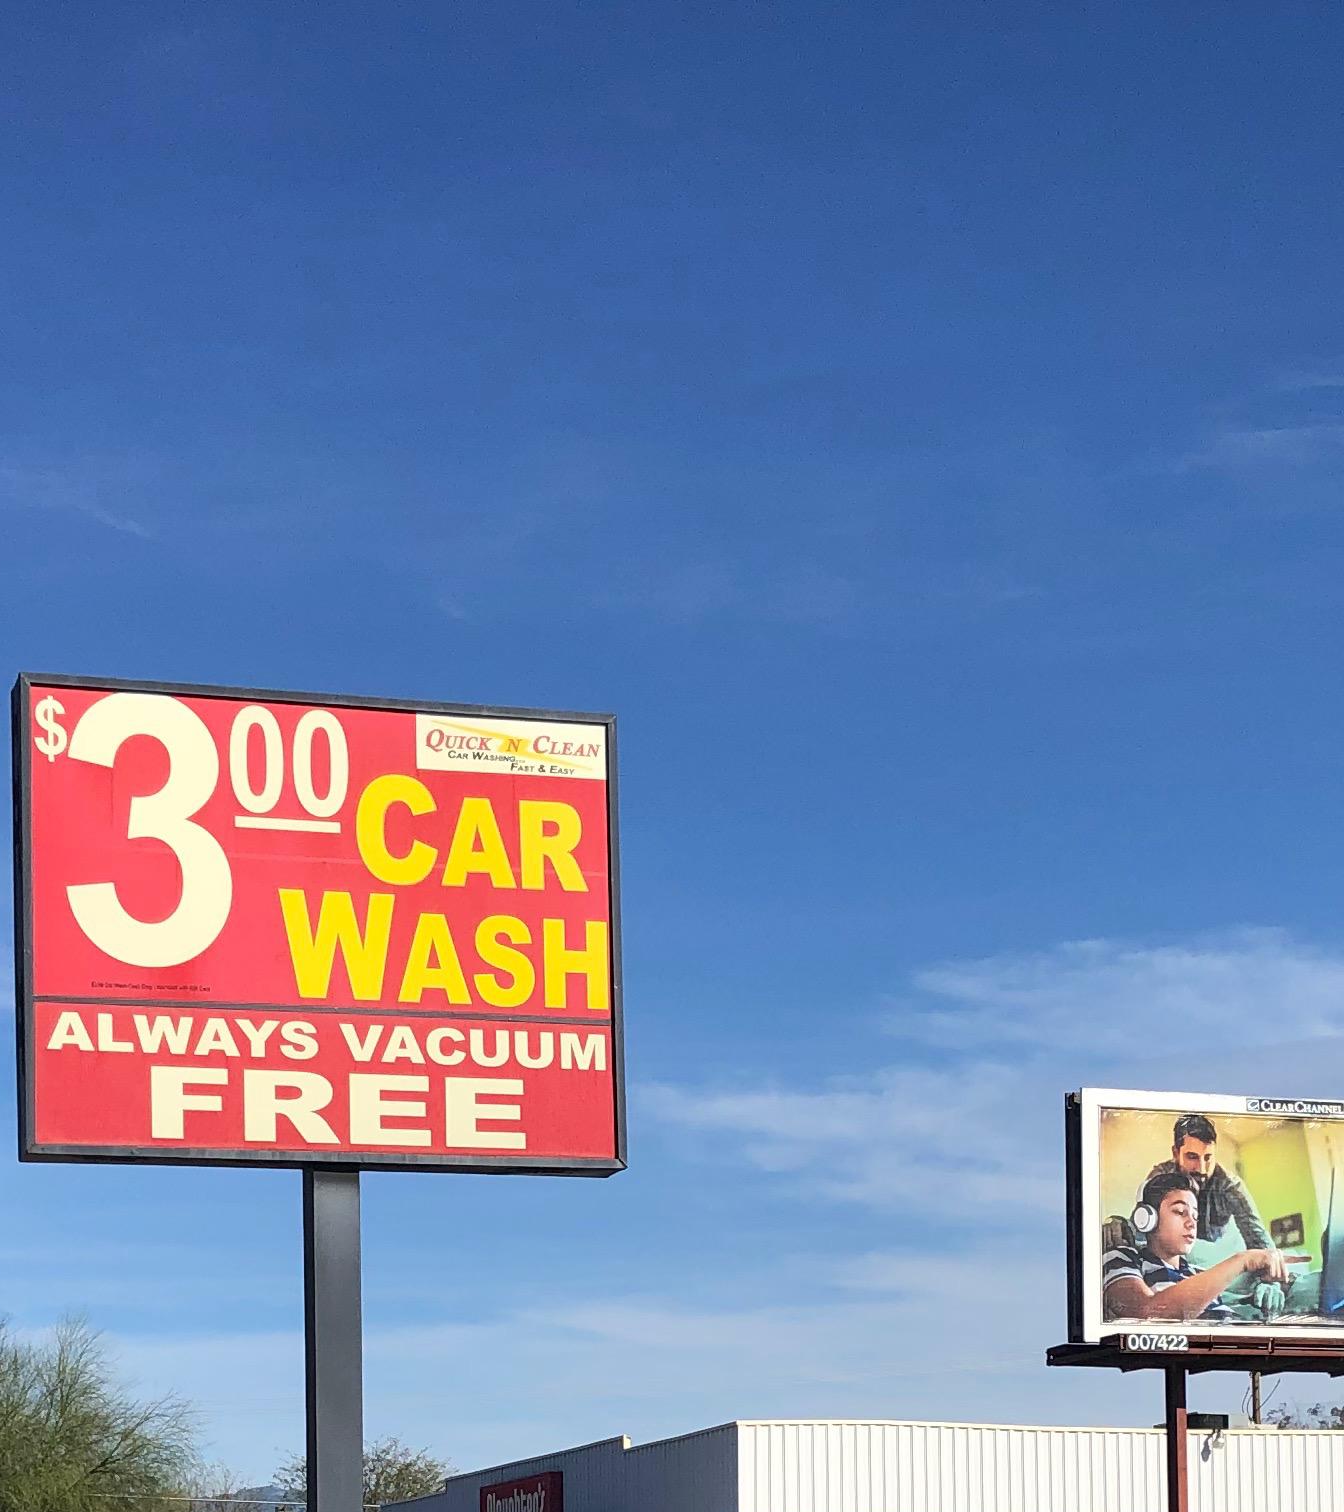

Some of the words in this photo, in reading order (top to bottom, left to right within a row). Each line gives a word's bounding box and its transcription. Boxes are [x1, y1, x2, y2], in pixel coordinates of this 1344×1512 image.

[426, 729, 492, 752] QUICK
[506, 739, 522, 752] N
[532, 735, 601, 757] CLEAN
[510, 762, 534, 772] FAST
[538, 763, 546, 773] &
[549, 765, 575, 775] EASY
[356, 774, 589, 891] CAR
[278, 888, 610, 1010] WASH
[46, 1010, 320, 1061] ALWAYS
[340, 1023, 608, 1072] VACUUM
[150, 1066, 527, 1150] FREE
[1127, 1334, 1189, 1351] 007422
